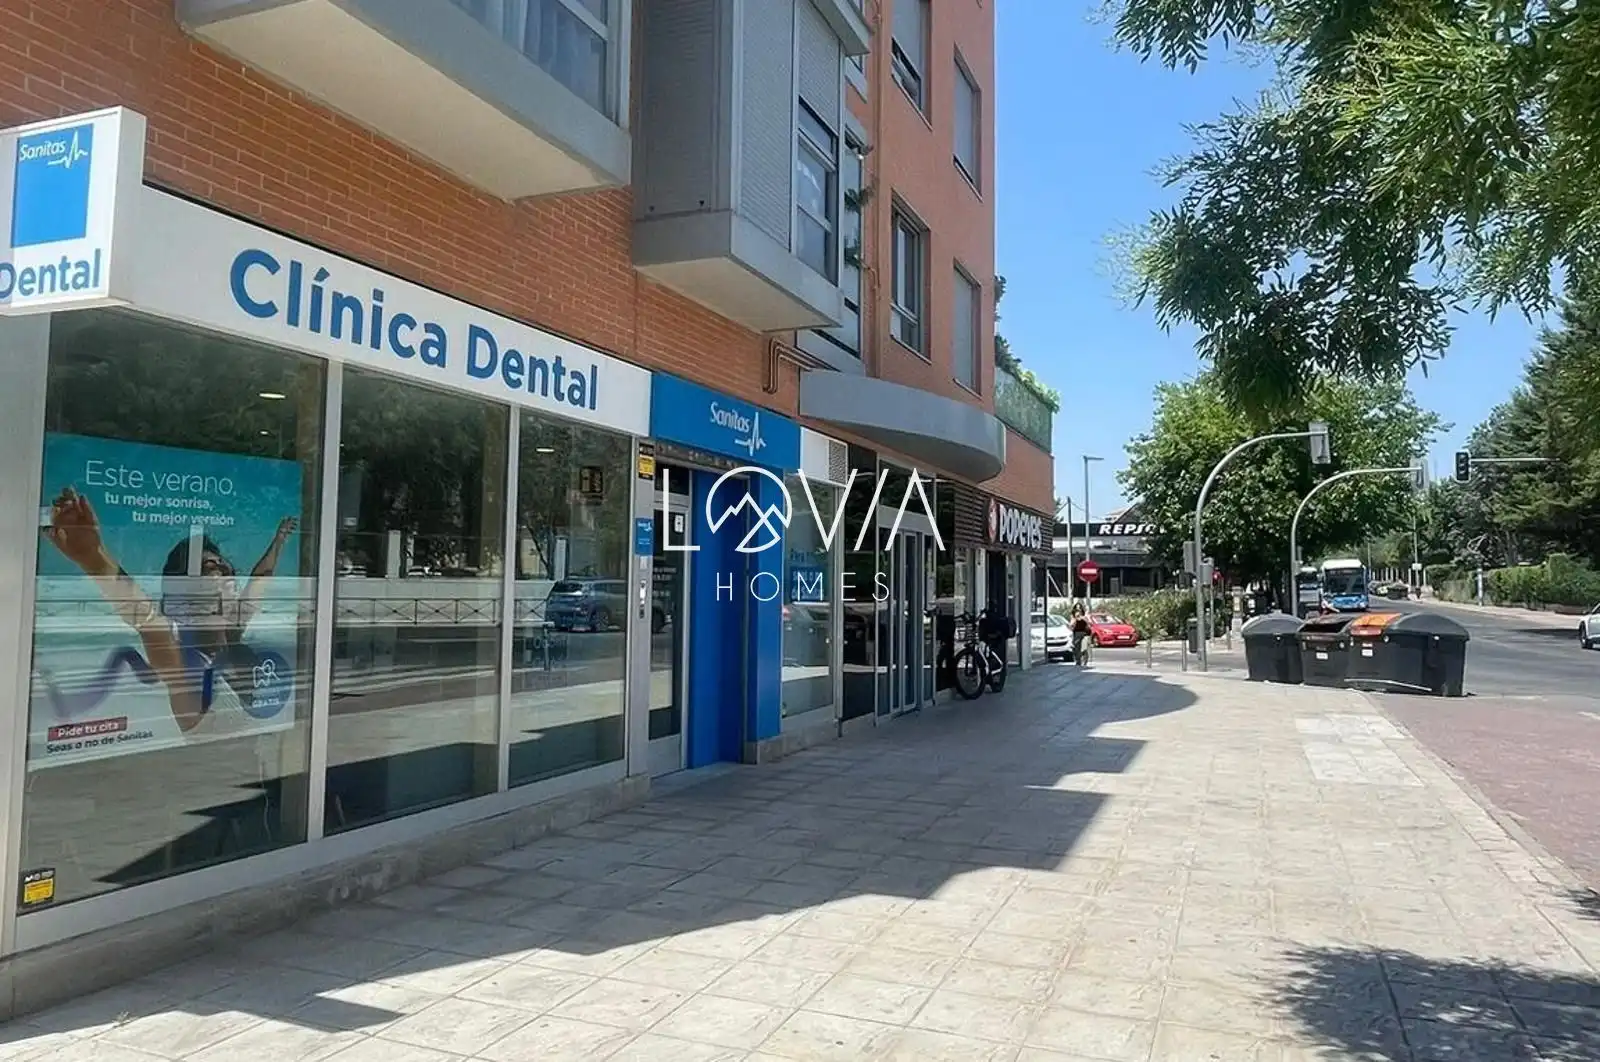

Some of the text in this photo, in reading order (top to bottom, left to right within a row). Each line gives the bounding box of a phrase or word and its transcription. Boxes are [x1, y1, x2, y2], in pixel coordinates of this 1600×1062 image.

[19, 140, 66, 161] Sanitas
[0, 248, 101, 299] Dental
[230, 248, 598, 410] Clínica Dental
[709, 401, 751, 432] Sanitas
[86, 460, 144, 488] Este
[105, 491, 214, 511] tu mejor sonrisa,
[132, 511, 234, 526] tu mejor versión
[57, 721, 119, 737] Pide tu cita
[47, 743, 73, 753] Seas
[100, 735, 115, 745] de
[117, 730, 153, 743] Sanitas
